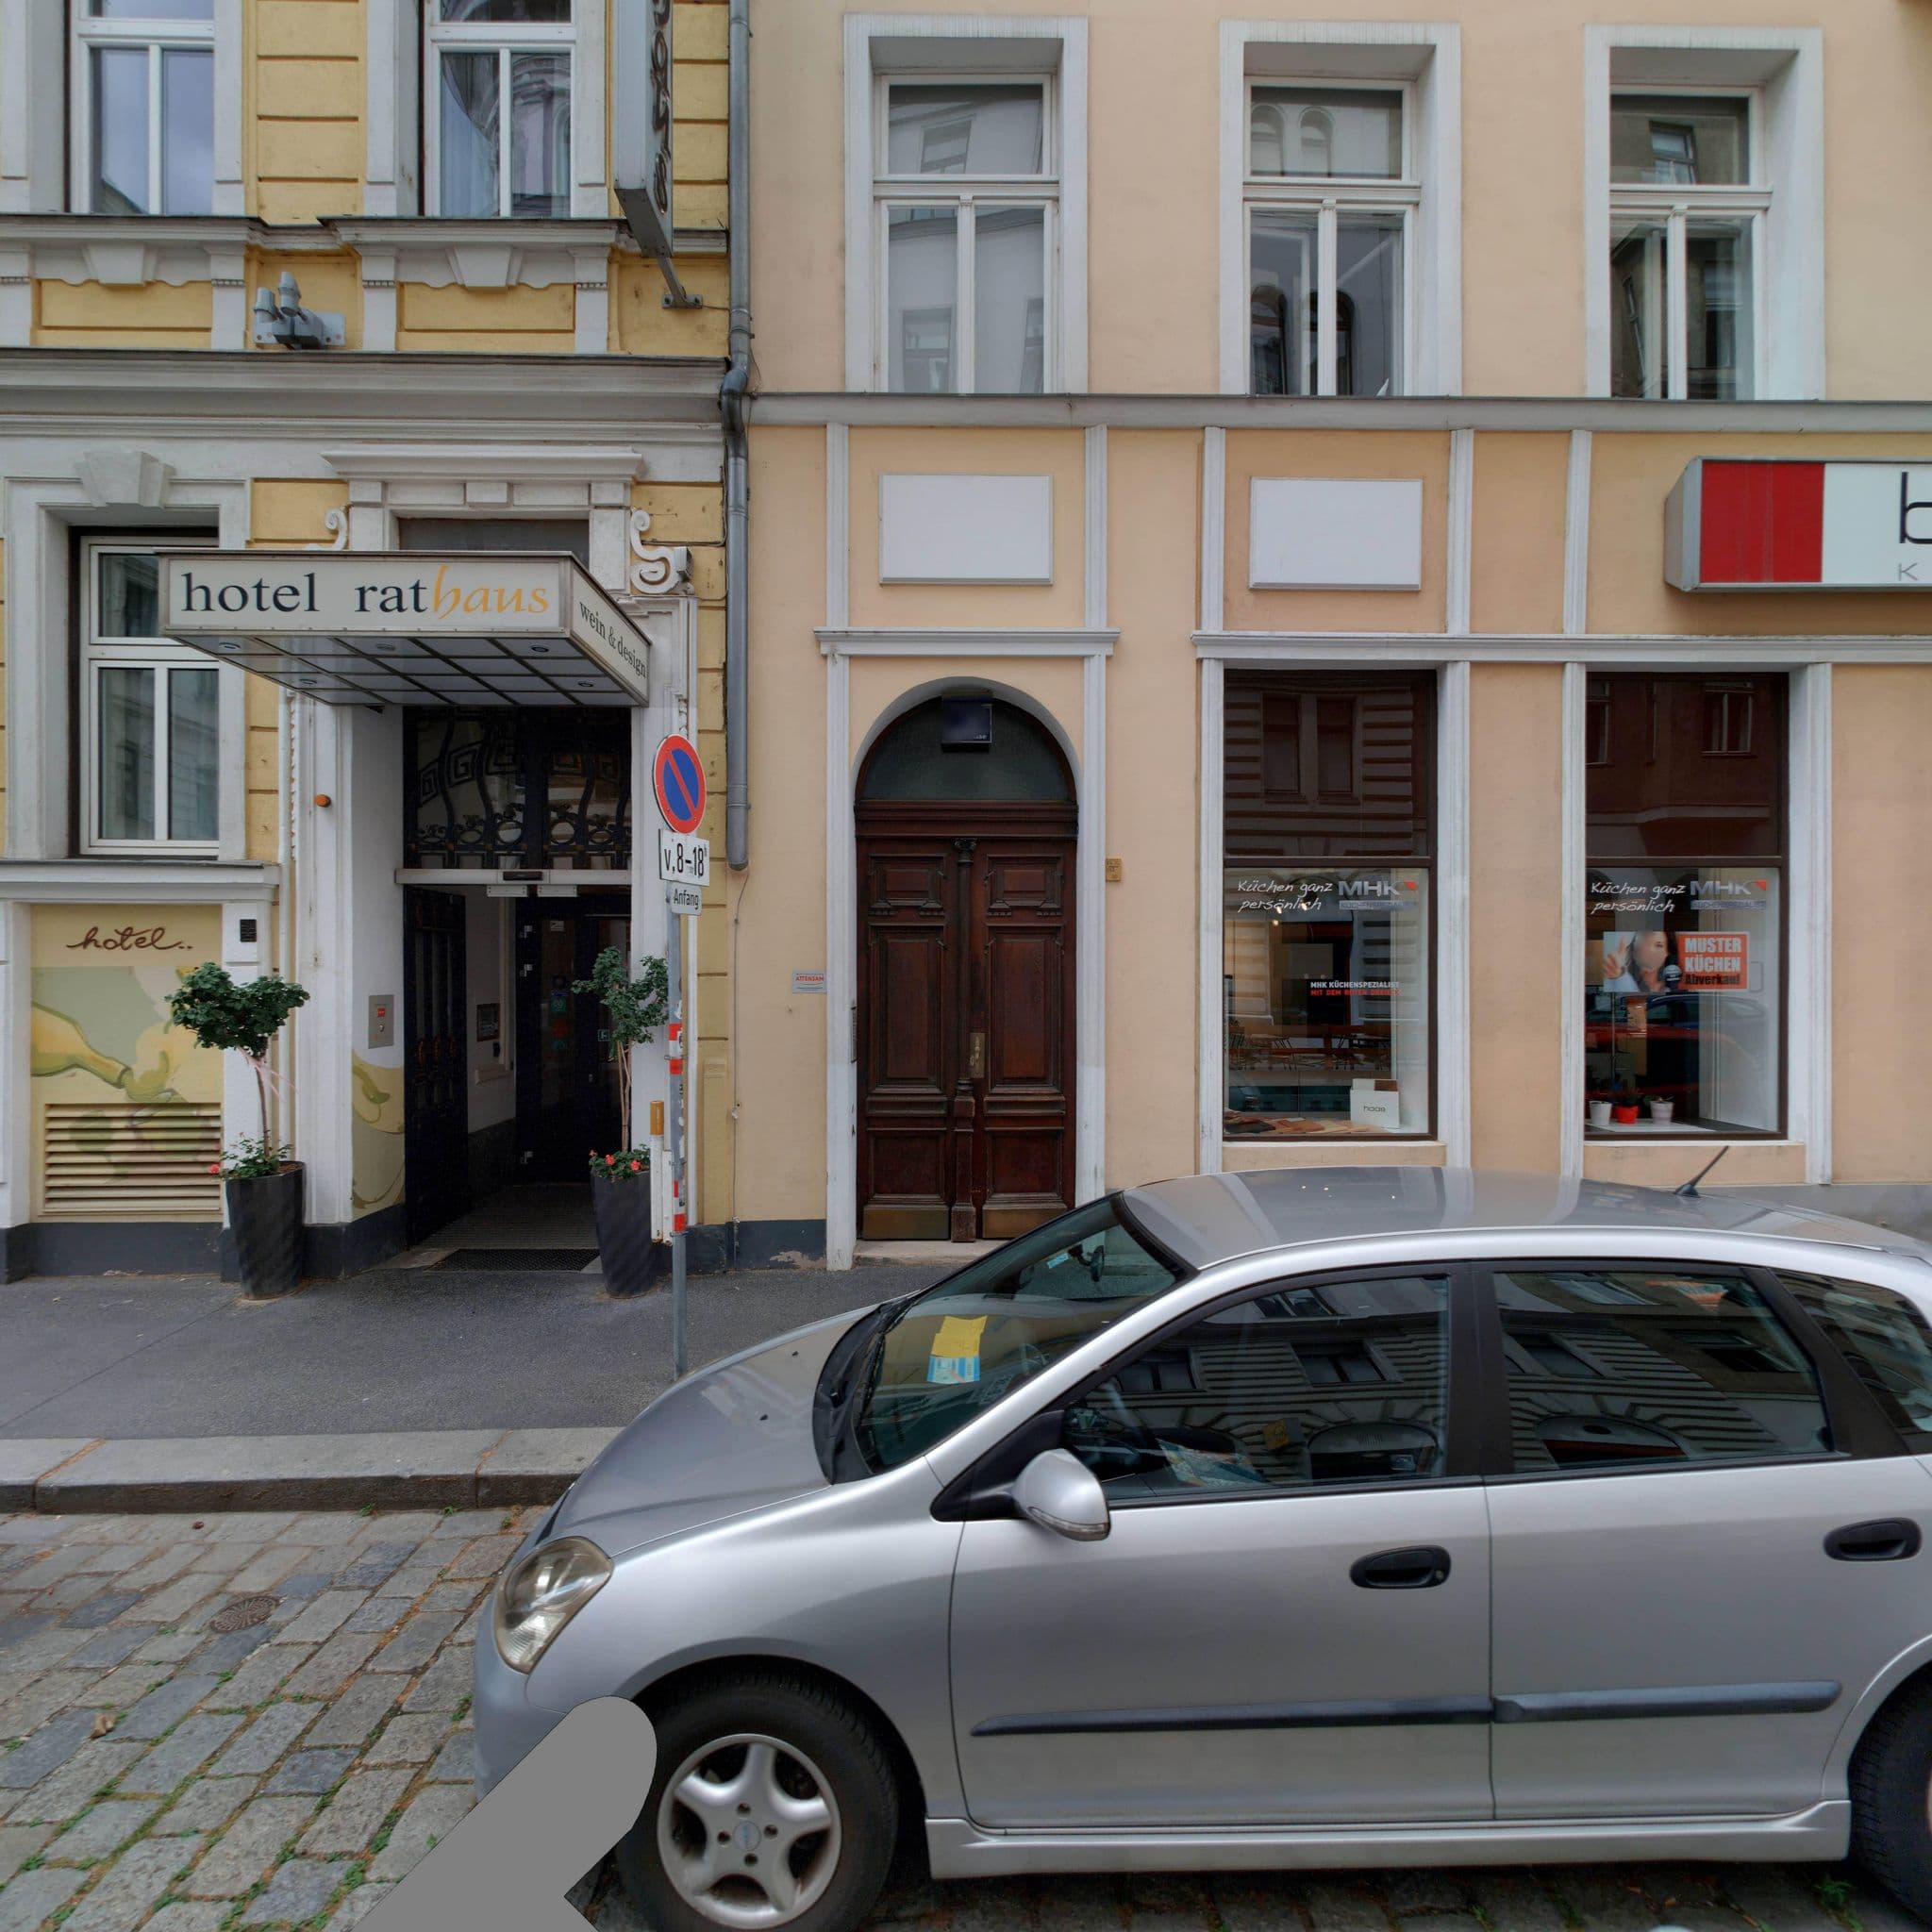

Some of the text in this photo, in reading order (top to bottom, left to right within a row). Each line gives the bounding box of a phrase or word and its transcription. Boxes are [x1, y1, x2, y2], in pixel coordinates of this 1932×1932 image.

[181, 565, 550, 620] hotel rathaus
[579, 601, 647, 678] wein & design
[1238, 880, 1334, 898] Küchen ganz
[1339, 880, 1401, 896] MHK
[1591, 881, 1686, 899] Küchen ganz
[1690, 880, 1752, 895] MHK
[674, 889, 699, 910] Anfang
[1238, 897, 1322, 913] persönlich
[1591, 898, 1675, 915] persönlich
[1685, 938, 1741, 953] MUSTER
[1685, 955, 1741, 973] KÜCHEN
[1685, 974, 1740, 985] Abverkauf
